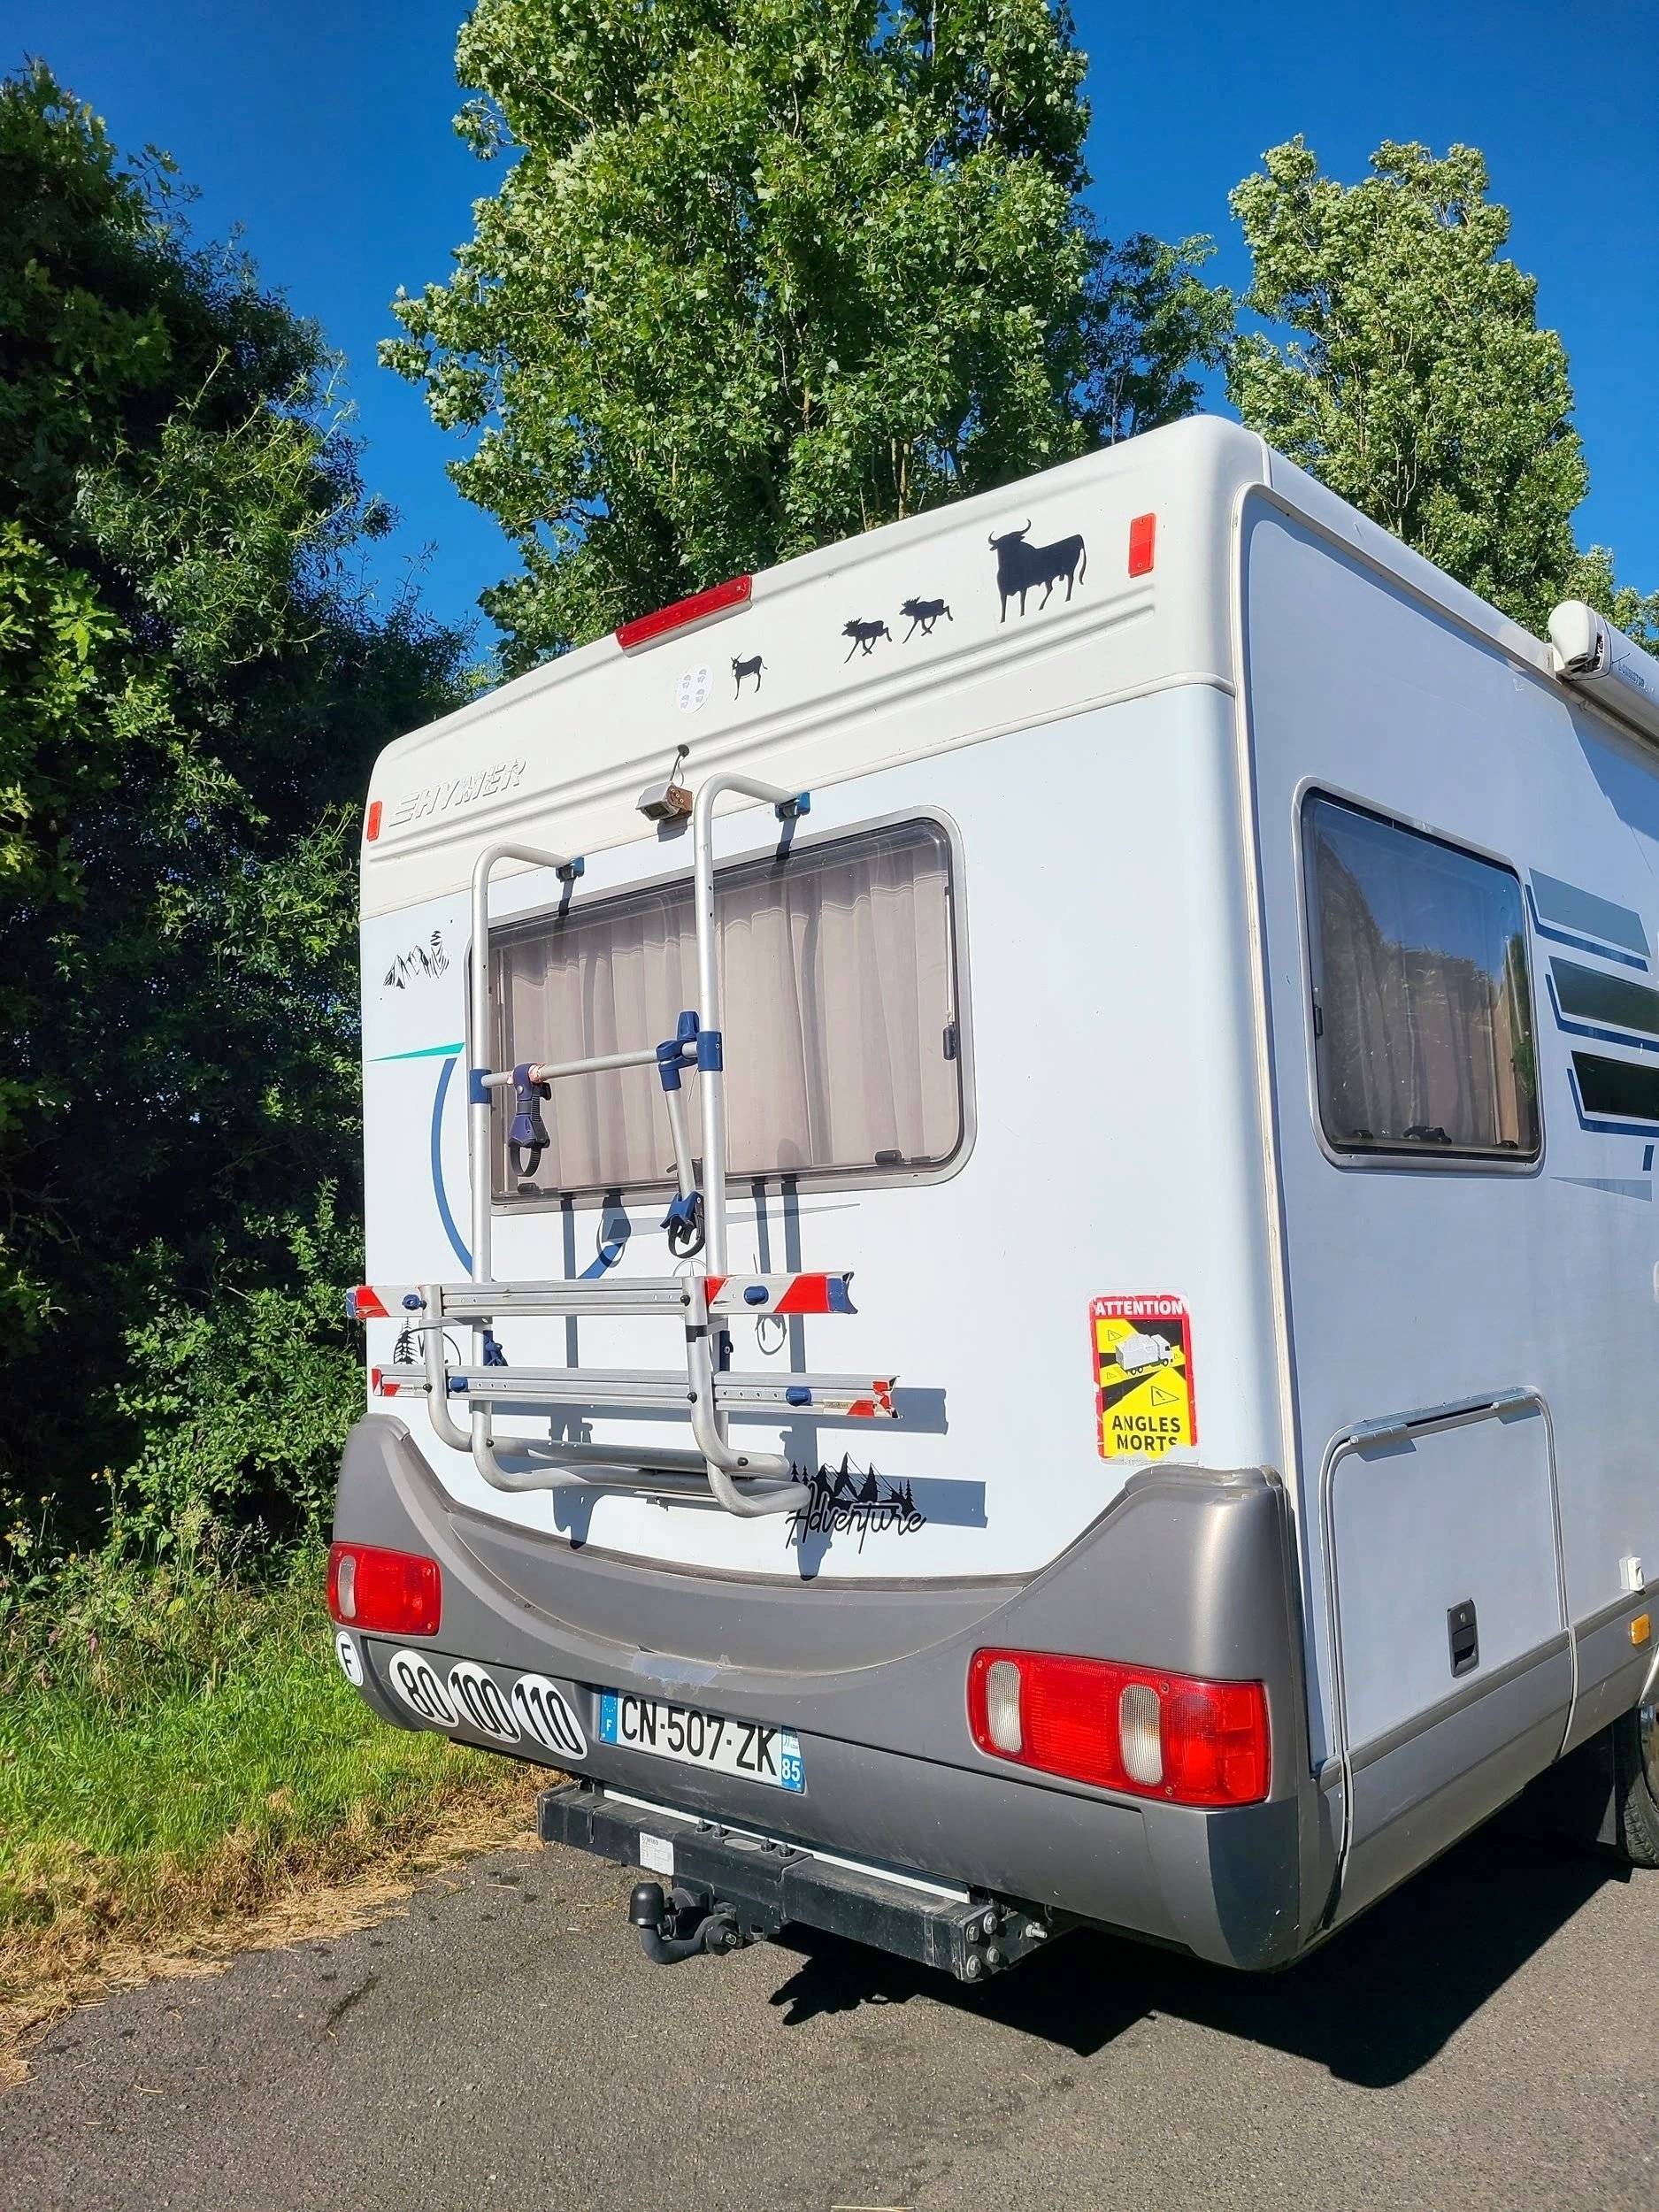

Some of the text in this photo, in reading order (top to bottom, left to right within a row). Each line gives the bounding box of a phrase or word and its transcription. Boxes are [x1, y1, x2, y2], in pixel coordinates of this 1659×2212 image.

[415, 757, 526, 820] HYMER
[1094, 1300, 1183, 1317] ATTENTION
[1111, 1416, 1181, 1433] ANGLES
[785, 1479, 927, 1555] Adventure
[341, 1643, 353, 1677] F
[396, 1661, 456, 1724] 80
[450, 1671, 519, 1740] 100
[514, 1683, 584, 1755] 110
[606, 1719, 612, 1732] F
[782, 1758, 801, 1782] 85
